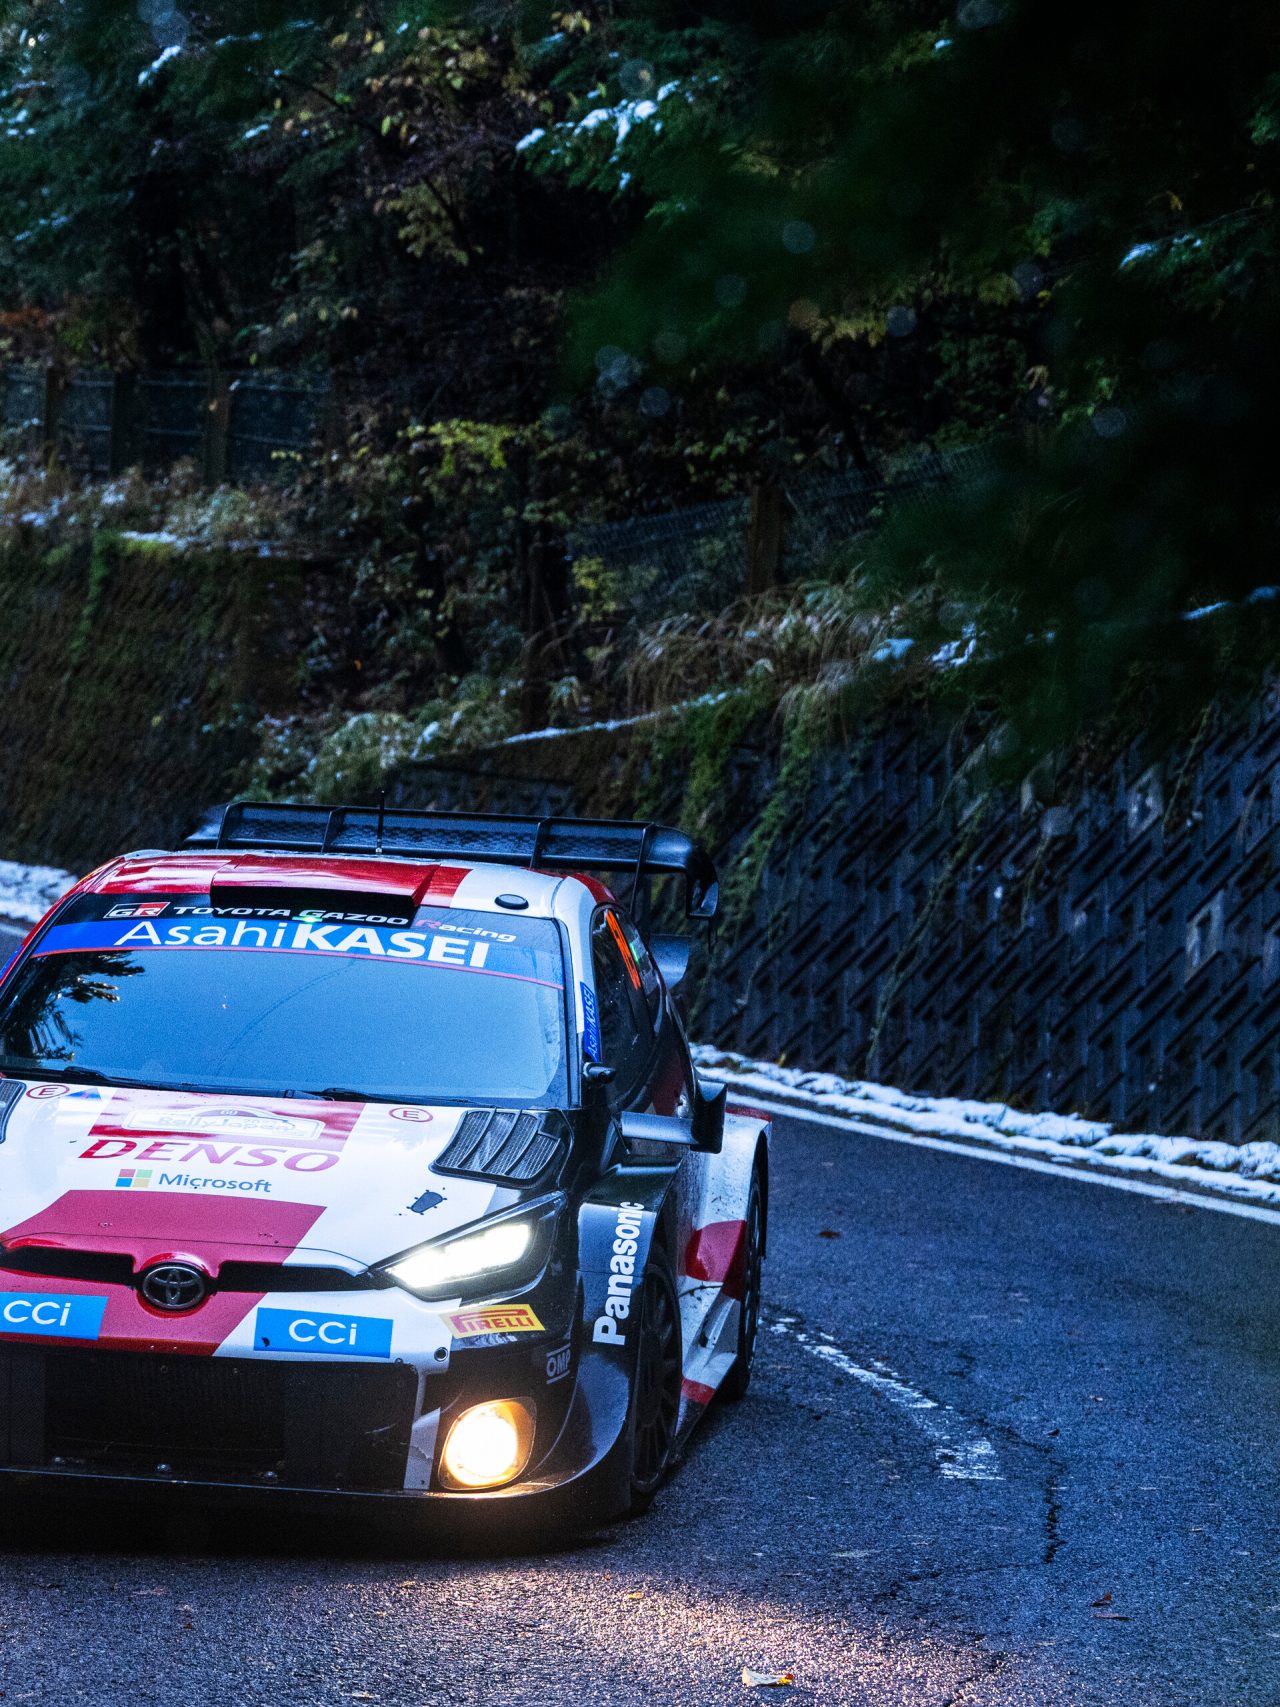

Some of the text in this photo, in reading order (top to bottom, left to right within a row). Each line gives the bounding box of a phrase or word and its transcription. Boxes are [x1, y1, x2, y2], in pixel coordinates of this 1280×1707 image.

[173, 906, 292, 917] TOYOTA
[298, 909, 409, 925] GAZOO
[415, 919, 517, 943] Racing
[113, 920, 490, 968] AsahiKASEI
[38, 1087, 58, 1096] E
[402, 1110, 420, 1119] E
[77, 1139, 341, 1173] DENSO
[158, 1172, 273, 1193] Microsoft
[591, 1201, 645, 1346] Panasonic
[2, 1300, 72, 1327] CCi
[449, 1308, 536, 1334] PIRELLI
[288, 1318, 359, 1346] CCi
[545, 1348, 571, 1378] OMP
